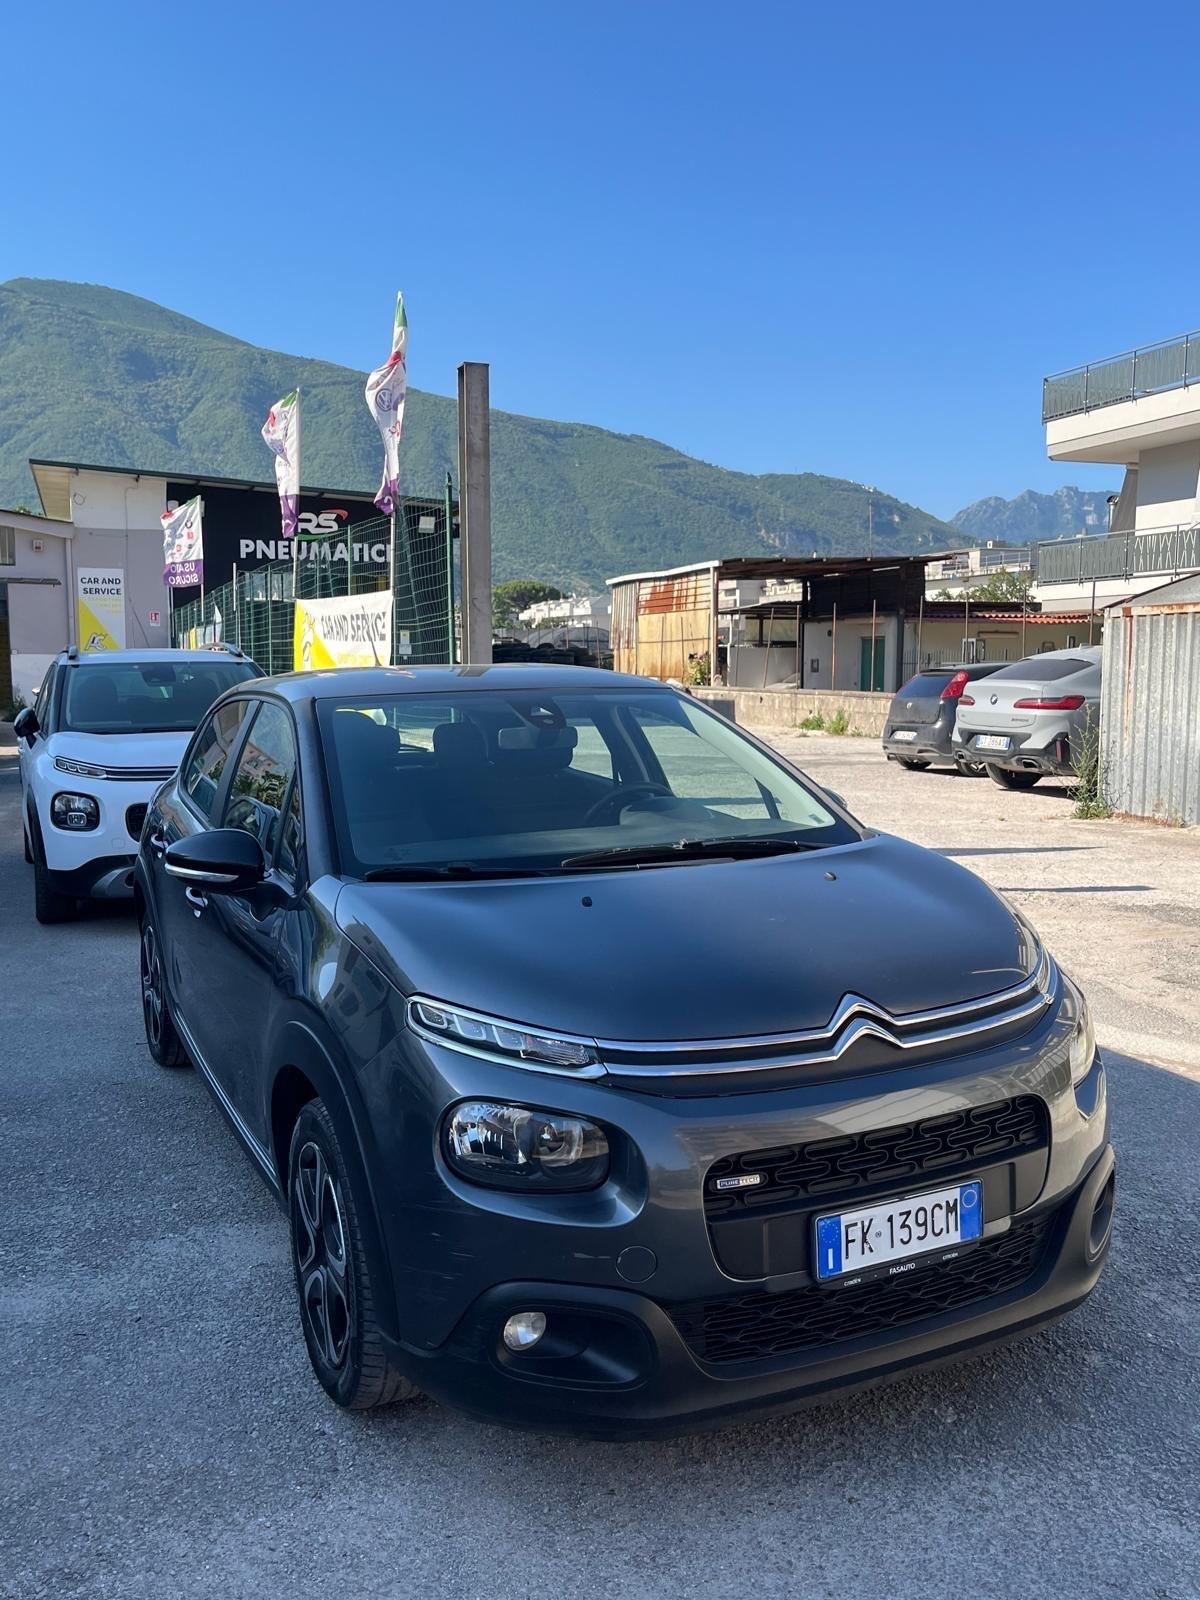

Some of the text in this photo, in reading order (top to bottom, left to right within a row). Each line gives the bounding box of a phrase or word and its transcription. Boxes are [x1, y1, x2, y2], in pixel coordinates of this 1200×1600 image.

[298, 511, 339, 534] RS
[239, 538, 392, 563] PNEUMATICI
[80, 577, 121, 585] CAR AND
[82, 587, 122, 596] SERVICE
[321, 611, 387, 642] CAR AND SERVICE
[844, 1197, 959, 1260] FK 139CM
[889, 1262, 916, 1275] FASAUTO
